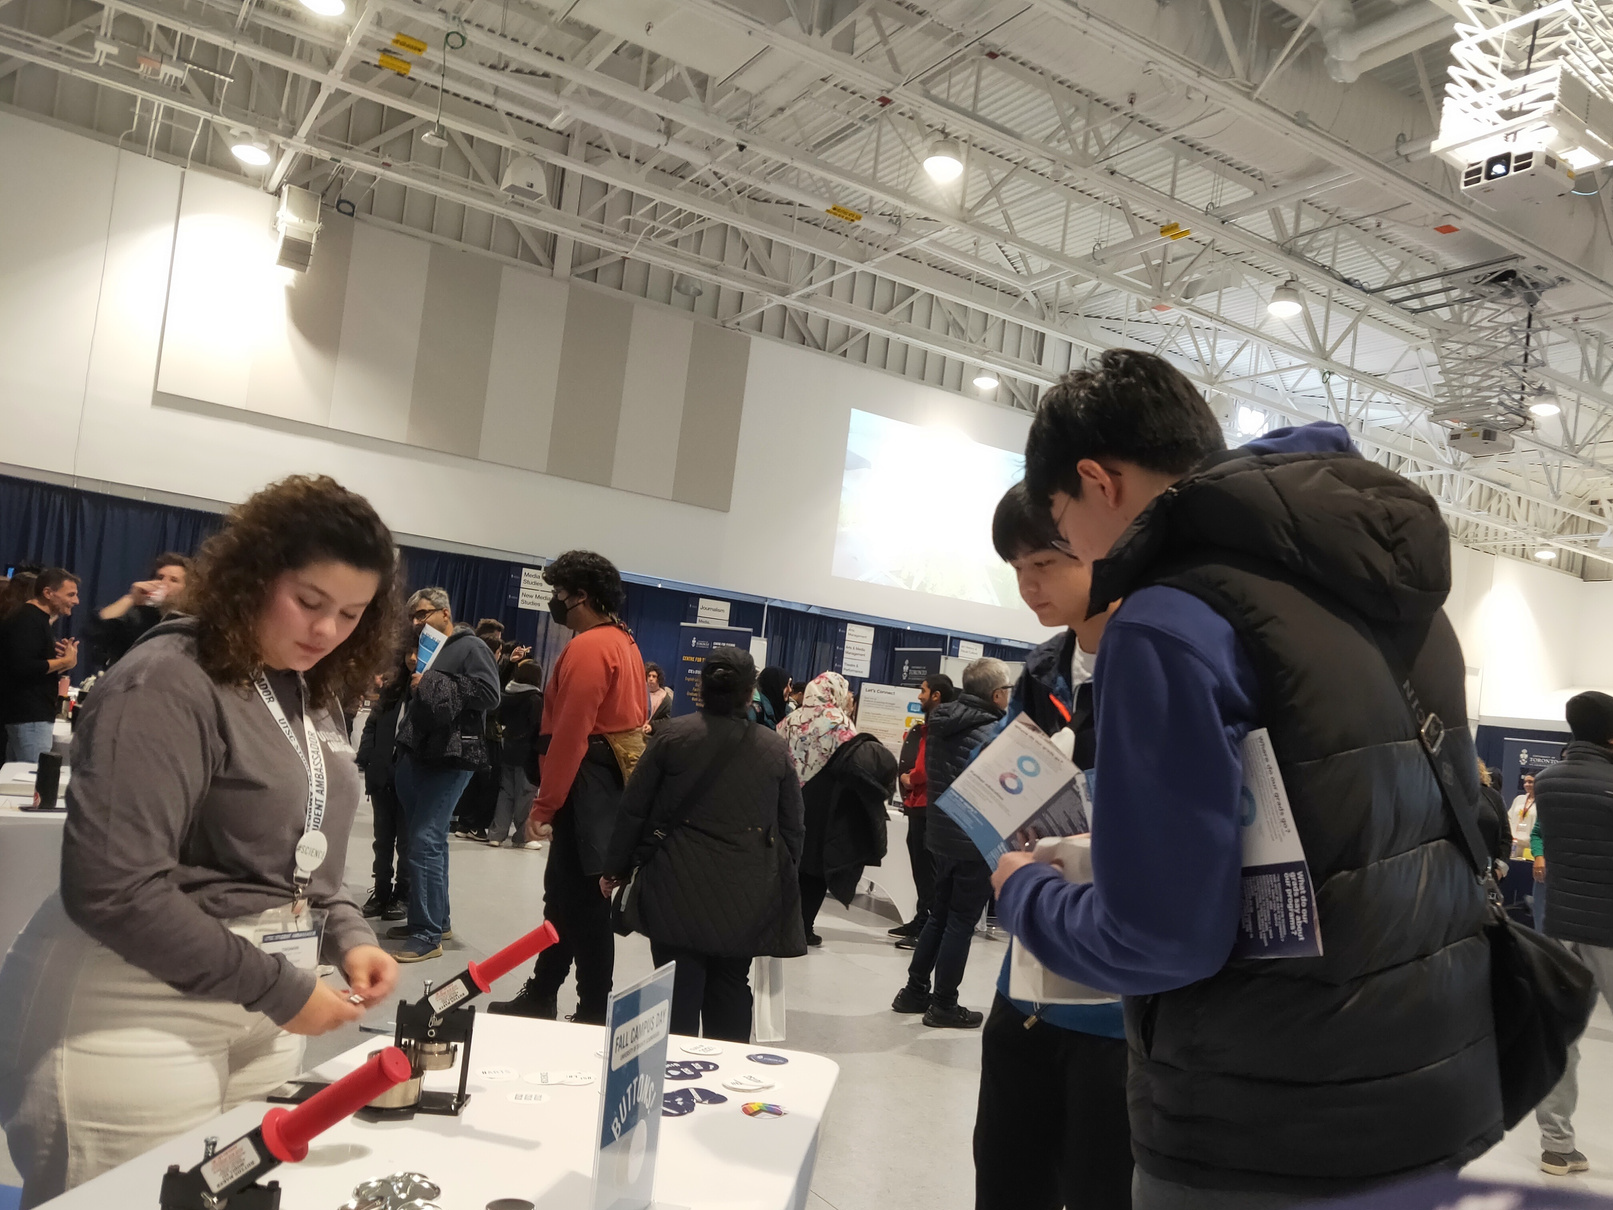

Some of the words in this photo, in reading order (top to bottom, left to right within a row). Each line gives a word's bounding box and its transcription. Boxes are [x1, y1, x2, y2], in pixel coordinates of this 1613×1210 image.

[523, 578, 543, 587] Studies
[524, 571, 541, 580] Media
[520, 599, 541, 607] Studies
[700, 604, 726, 614] Journalism
[307, 730, 325, 797] AMBASSADOR
[1258, 735, 1270, 763] Where
[1266, 763, 1273, 775] do
[1274, 792, 1284, 816] grads
[1280, 817, 1291, 834] go?
[1284, 872, 1292, 888] our
[1289, 871, 1300, 897] grads
[1297, 871, 1306, 895] What
[1293, 897, 1301, 914] say
[1300, 895, 1308, 908] do
[1285, 888, 1298, 936] programs?
[1296, 915, 1305, 941] about
[615, 1030, 629, 1054] FALL
[630, 1015, 655, 1044] CAMPUS
